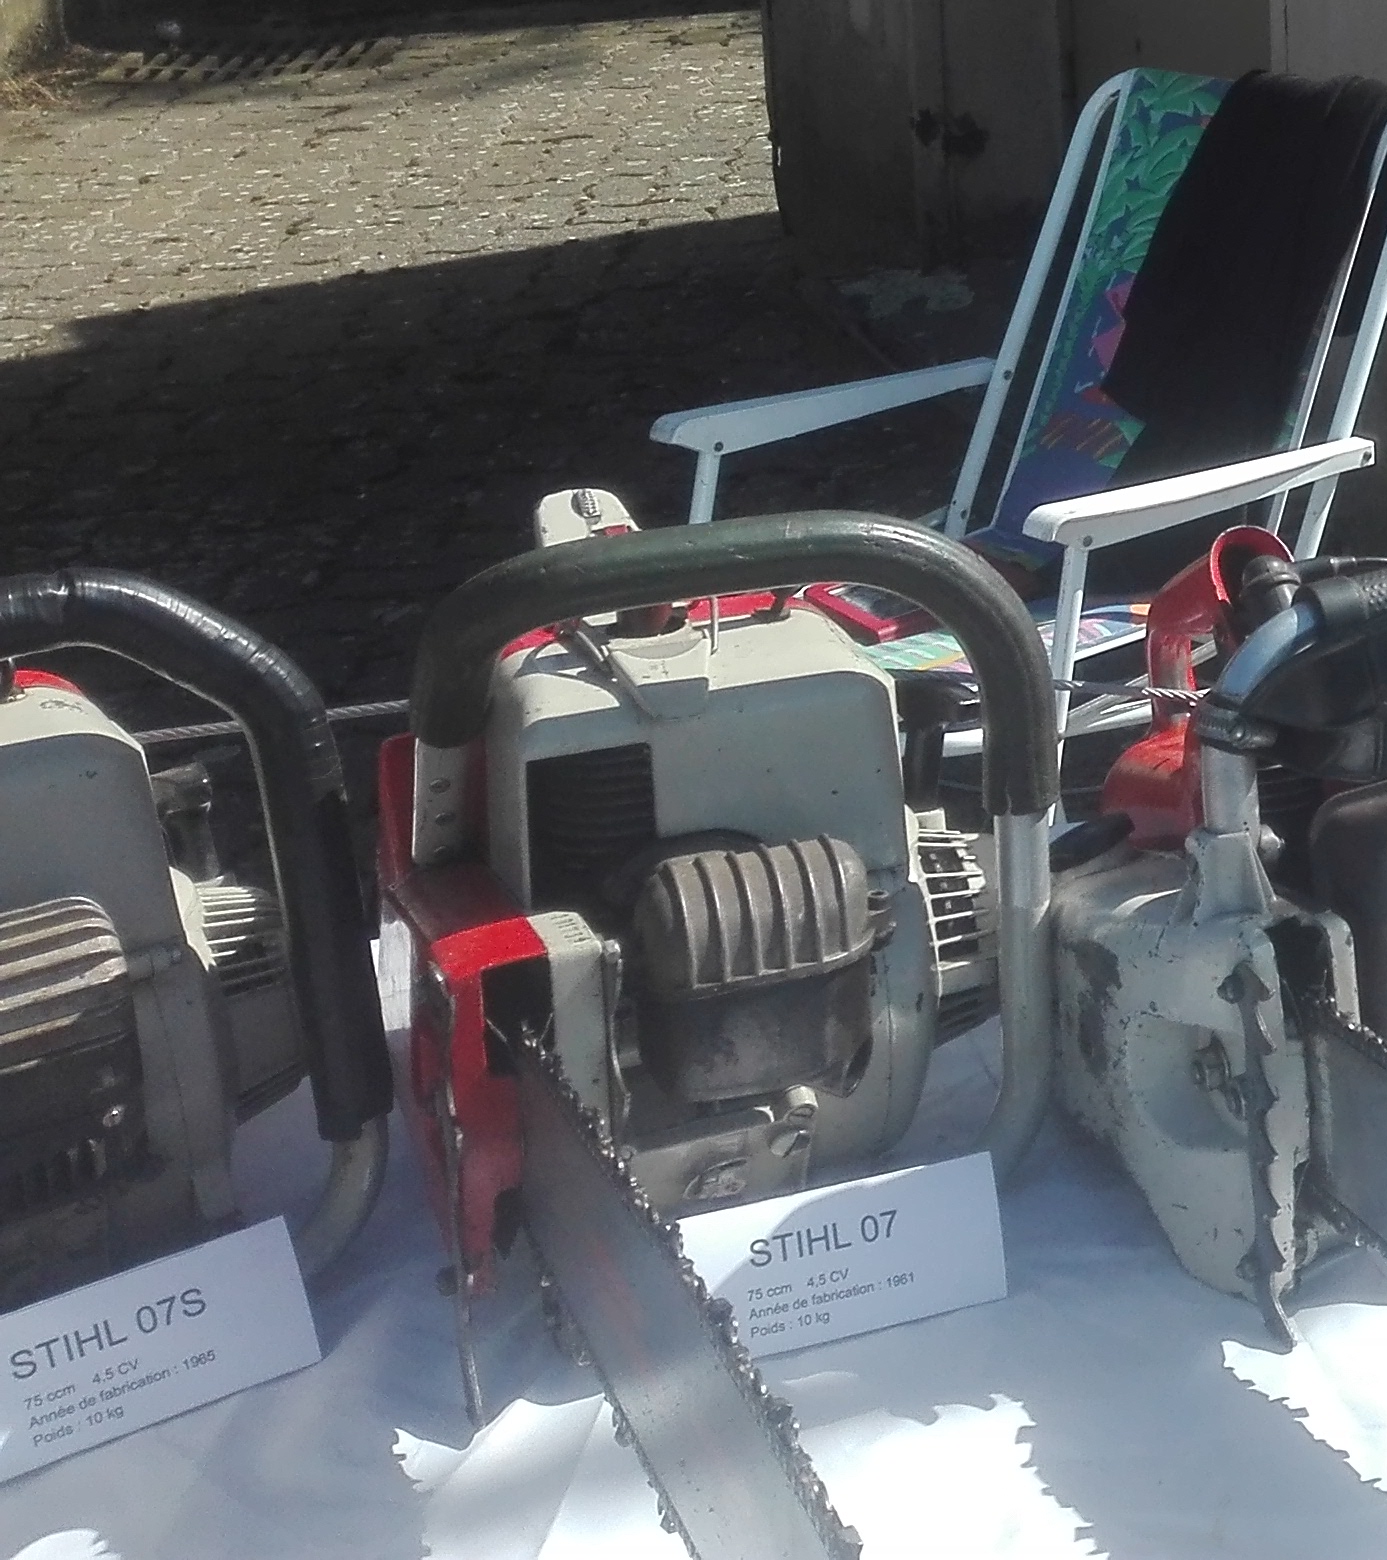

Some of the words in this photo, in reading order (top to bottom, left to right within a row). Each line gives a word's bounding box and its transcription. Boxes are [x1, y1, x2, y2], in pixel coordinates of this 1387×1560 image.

[749, 1221, 853, 1268] STIHL
[859, 1209, 898, 1242] 07
[746, 1288, 763, 1302] 75
[767, 1283, 793, 1299] ccm
[806, 1273, 827, 1288] 4,5
[828, 1267, 850, 1283] CV
[749, 1302, 789, 1321] Année
[792, 1297, 808, 1310] de
[811, 1282, 875, 1306] fabrication
[886, 1271, 916, 1289] 1961
[10, 1319, 129, 1381] STIHL
[135, 1287, 207, 1335] 07S
[750, 1322, 786, 1339] Poids
[798, 1313, 813, 1328] 10
[814, 1311, 831, 1326] kg
[23, 1393, 43, 1411] 75
[46, 1383, 76, 1403] ccm
[91, 1369, 115, 1386] 4,5
[116, 1358, 140, 1376] CV
[28, 1403, 77, 1431] Année
[78, 1396, 97, 1410] de
[99, 1368, 171, 1403] fabrication
[33, 1424, 74, 1448] Poids
[86, 1412, 104, 1427] 10
[103, 1404, 125, 1426] kg
